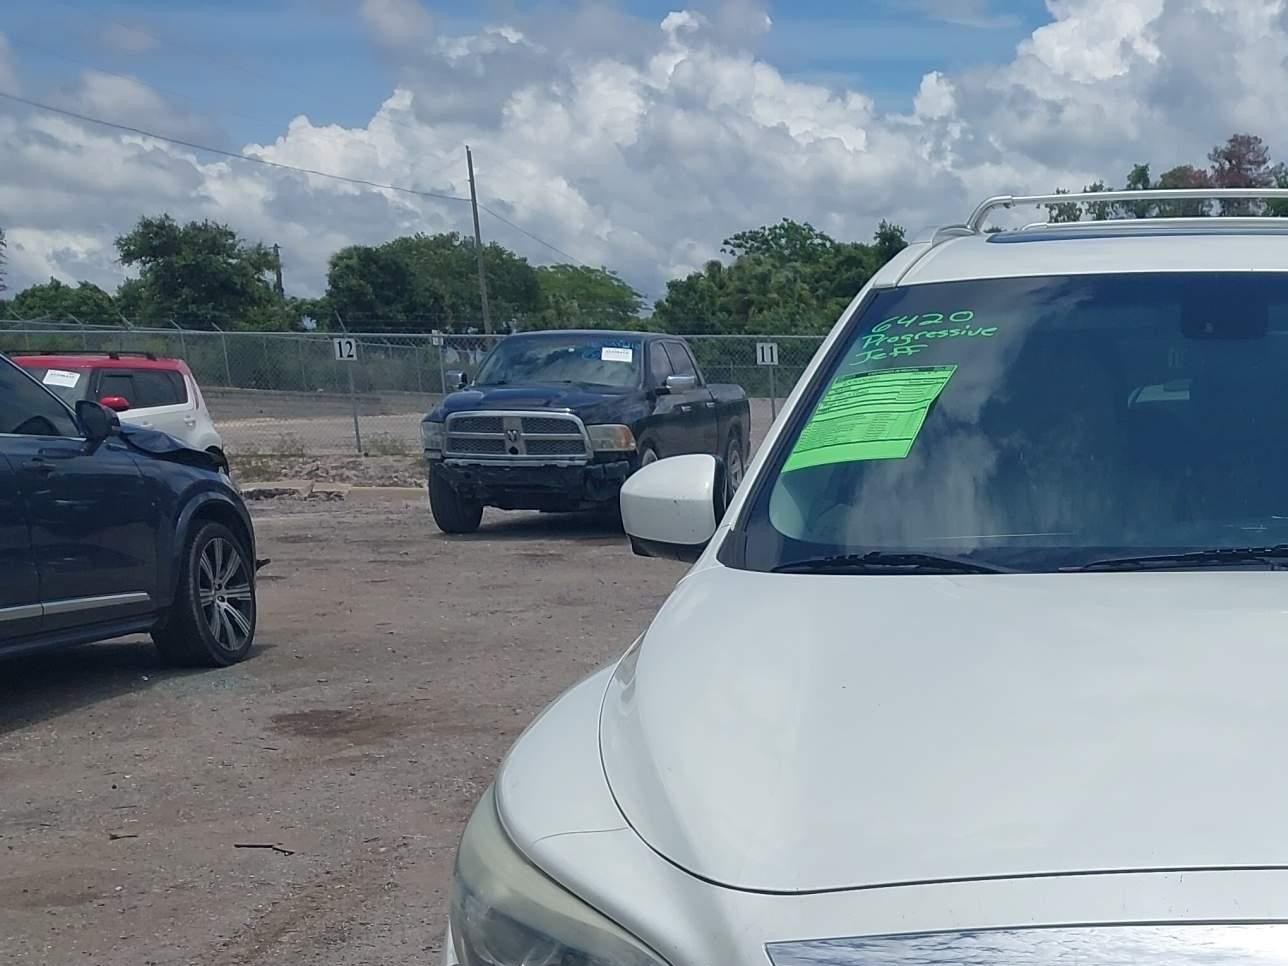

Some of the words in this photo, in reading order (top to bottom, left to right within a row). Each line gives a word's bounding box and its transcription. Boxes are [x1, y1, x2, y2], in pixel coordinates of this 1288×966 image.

[871, 310, 974, 333] 6420
[862, 325, 998, 348] Progressive
[336, 340, 354, 358] 12
[759, 345, 775, 363] 11
